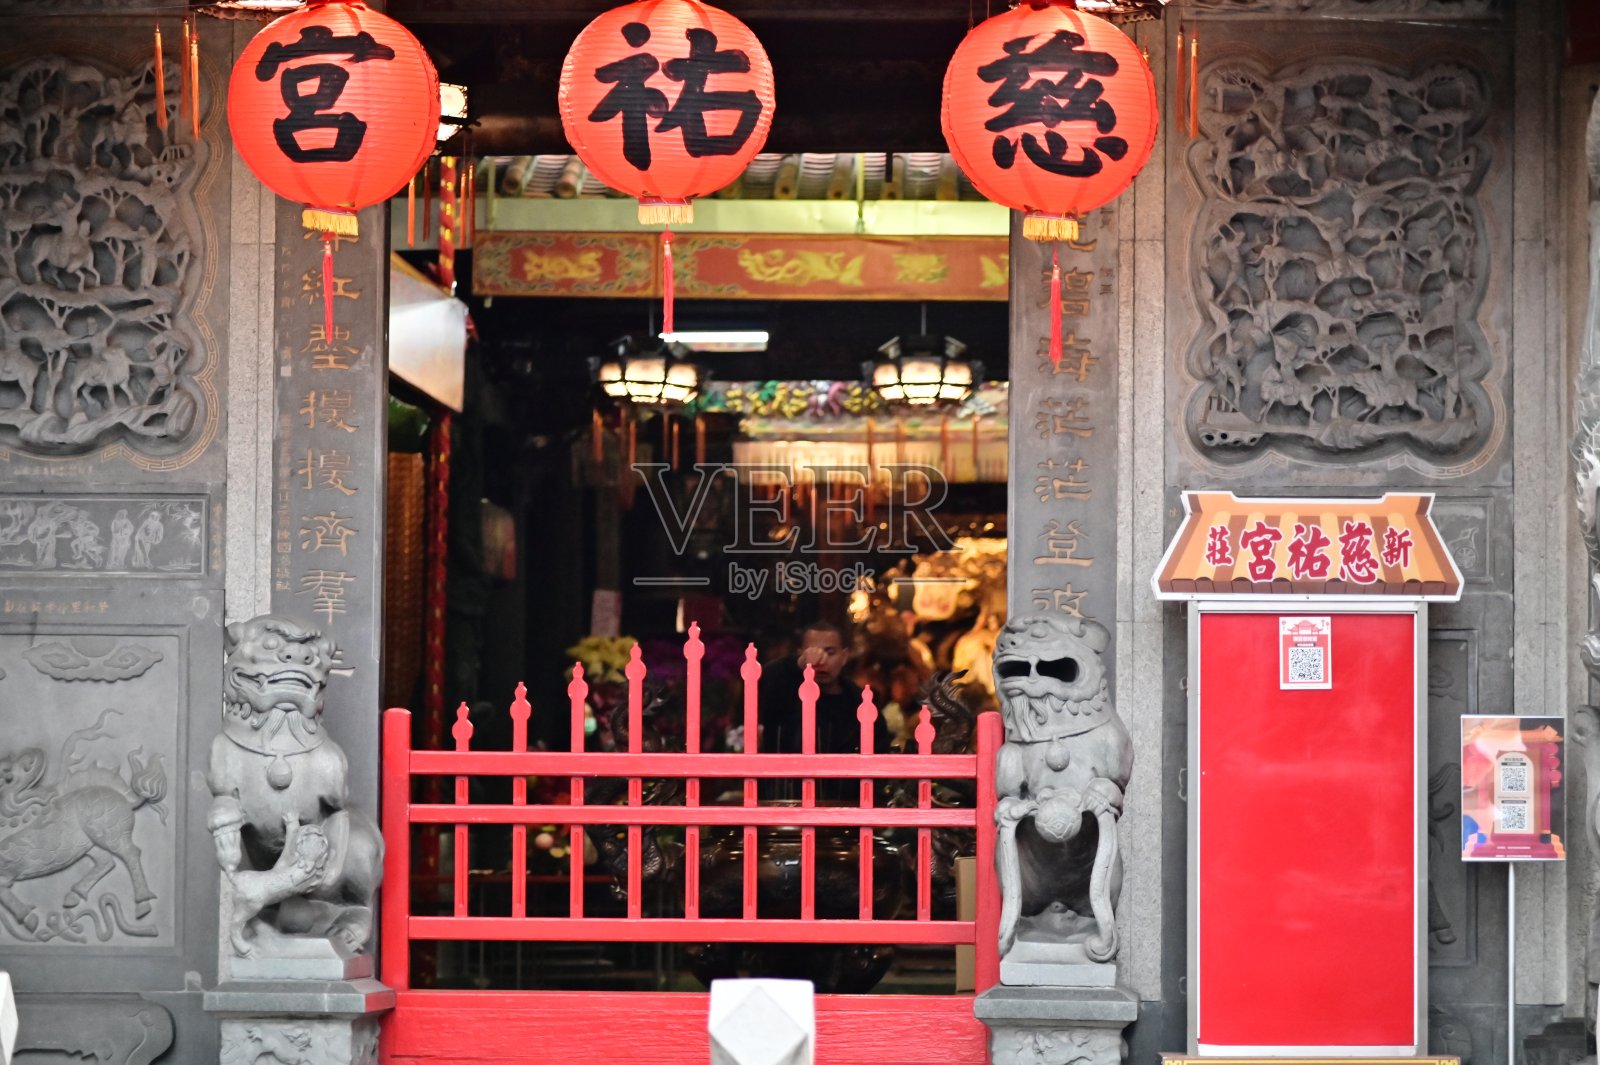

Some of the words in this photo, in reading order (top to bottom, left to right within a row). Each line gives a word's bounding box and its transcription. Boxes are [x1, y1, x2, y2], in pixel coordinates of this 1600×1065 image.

[255, 25, 395, 163] 宮
[588, 22, 763, 171] 祐
[977, 30, 1128, 178] 慈
